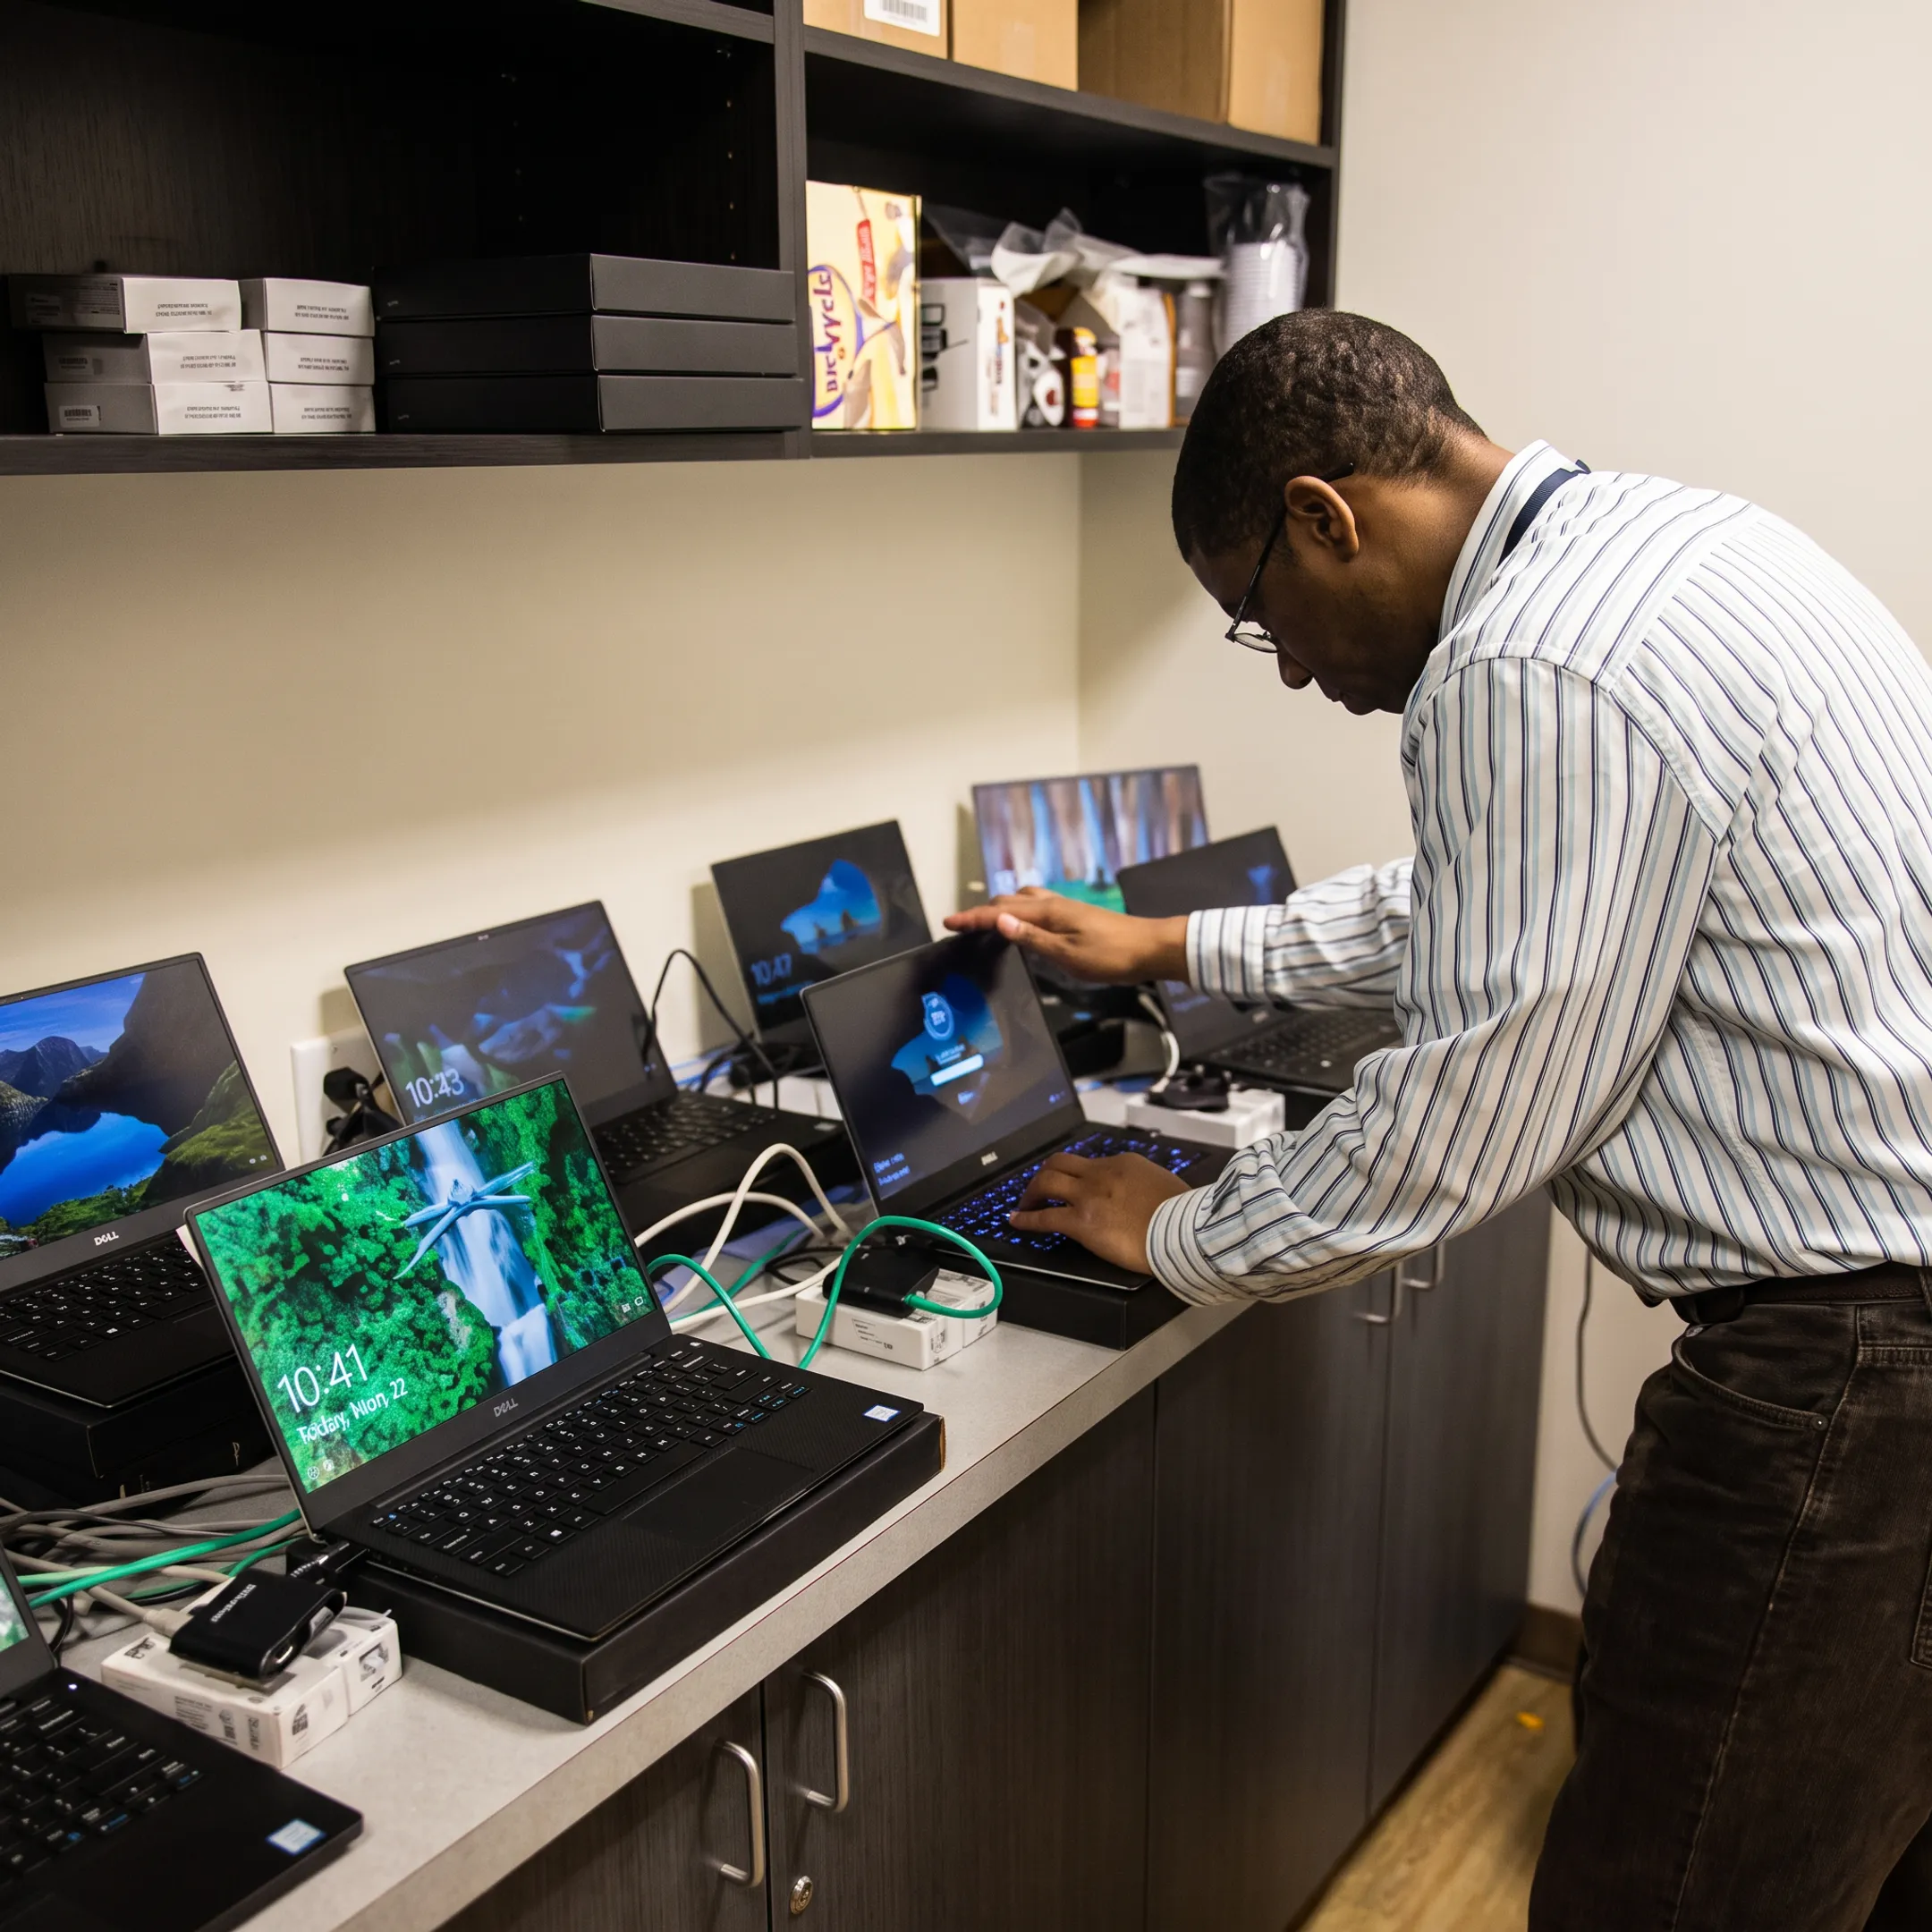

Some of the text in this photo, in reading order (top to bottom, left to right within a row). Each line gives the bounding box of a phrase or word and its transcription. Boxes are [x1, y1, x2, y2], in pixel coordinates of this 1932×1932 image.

[405, 1068, 464, 1107] 10:43
[277, 1343, 368, 1413] 10:41
[390, 1377, 408, 1400] 22
[493, 1398, 518, 1417] DELL
